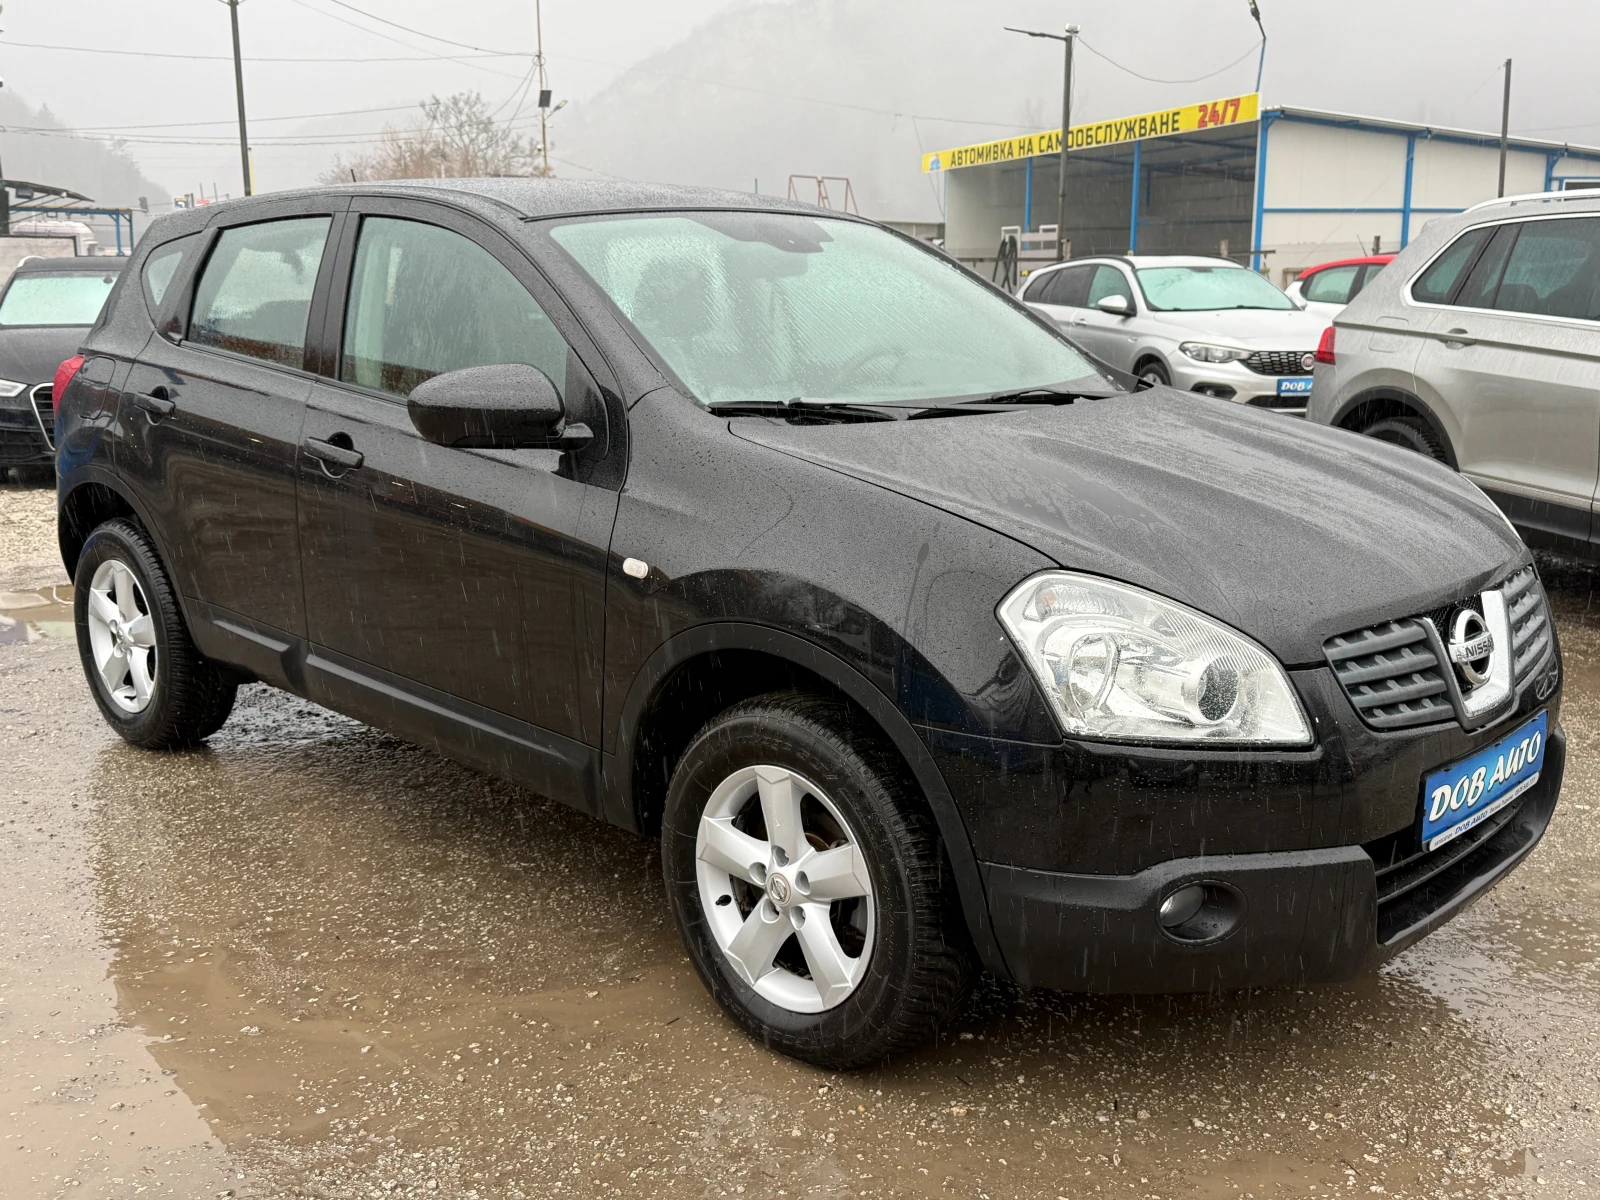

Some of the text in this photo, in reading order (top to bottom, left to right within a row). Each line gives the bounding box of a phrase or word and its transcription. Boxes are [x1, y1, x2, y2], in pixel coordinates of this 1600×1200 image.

[950, 97, 1241, 167] АВТОМИВКА НА САМООБСЛУЖВАНЕ 24/7
[1281, 381, 1305, 391] DOB
[1429, 730, 1541, 822] DOB AUTO
